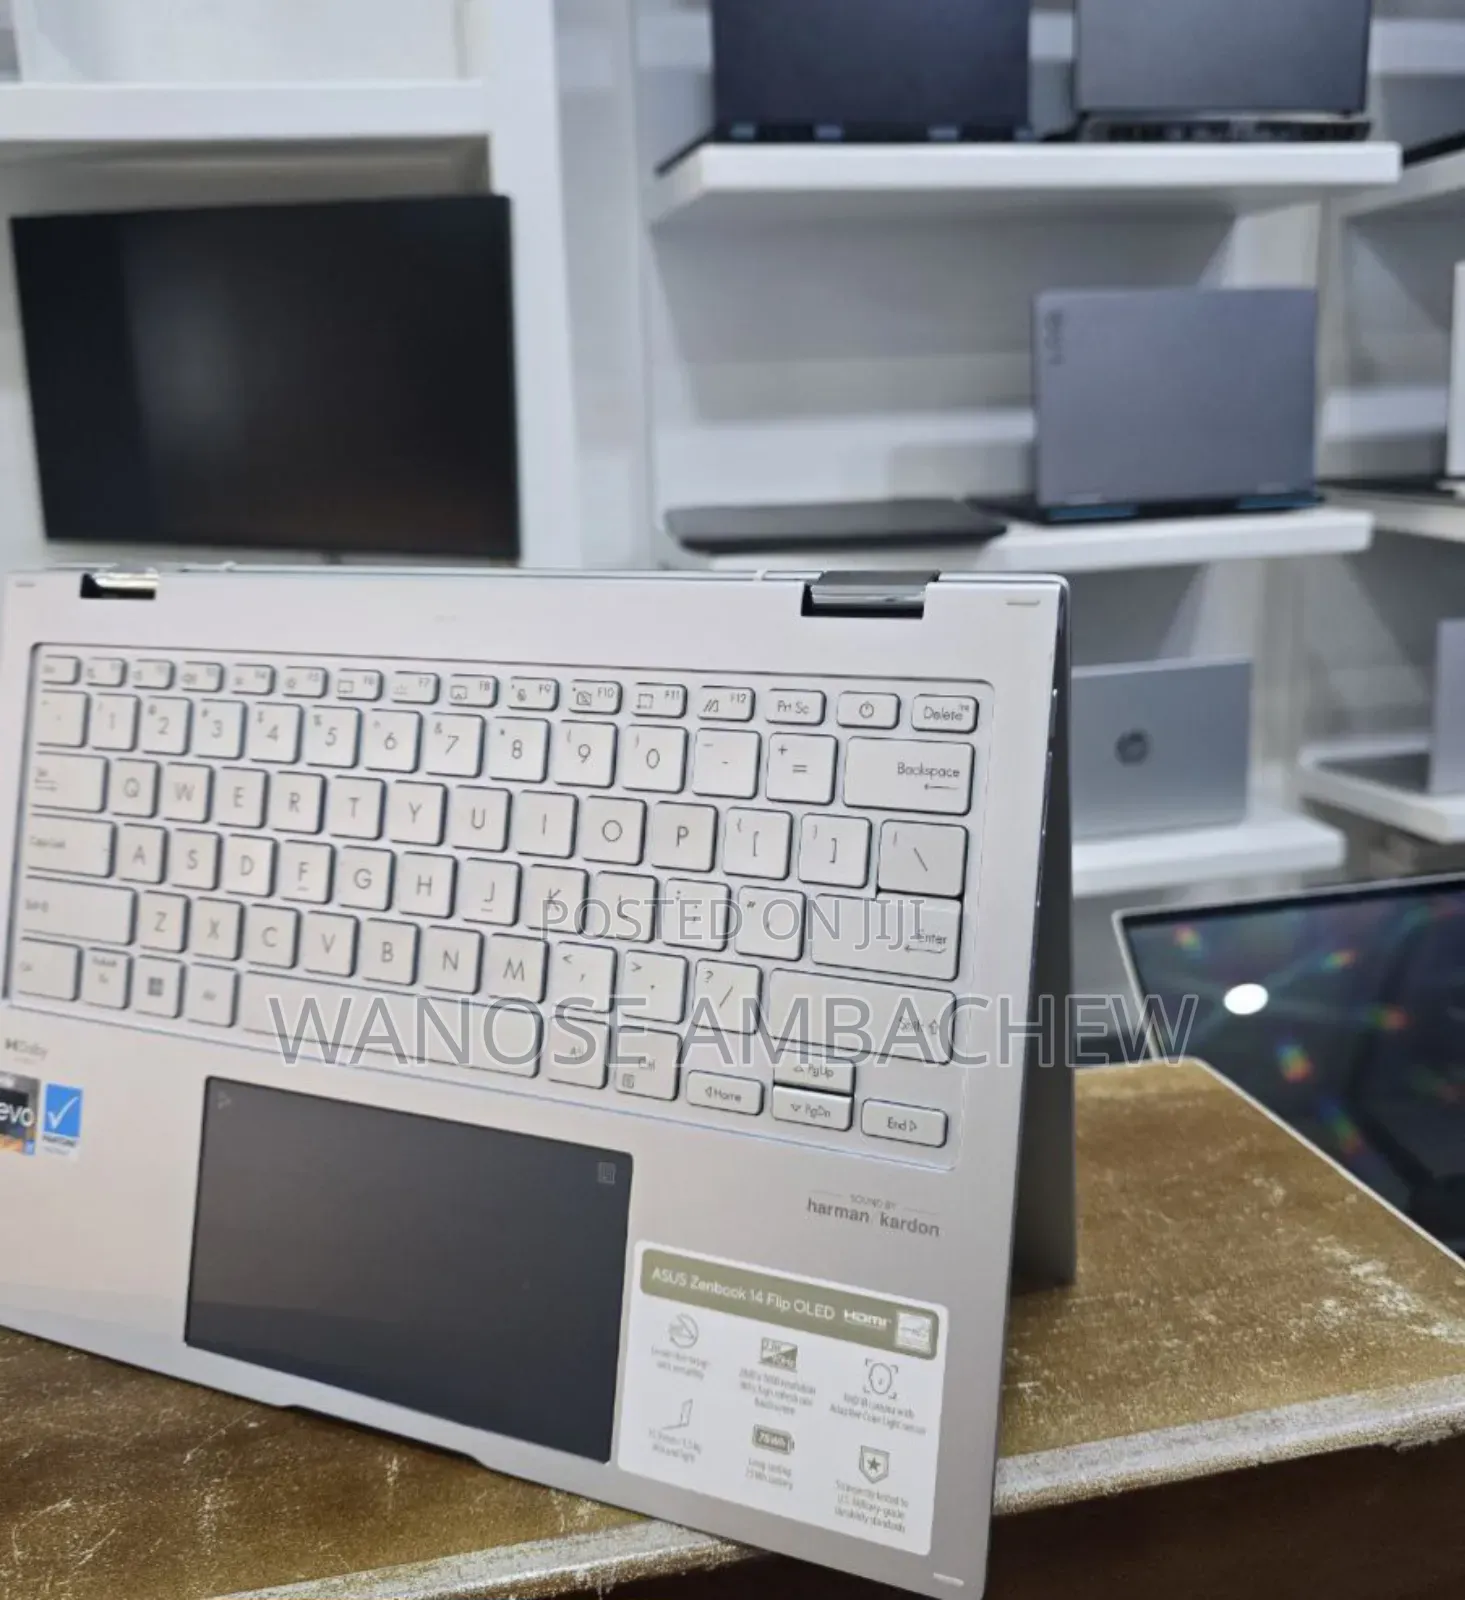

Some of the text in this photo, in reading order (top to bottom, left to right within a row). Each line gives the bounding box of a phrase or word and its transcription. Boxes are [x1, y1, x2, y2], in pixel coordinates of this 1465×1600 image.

[418, 678, 430, 688] F7
[479, 680, 490, 691] F8
[539, 684, 551, 695] F9
[597, 687, 614, 698] F10
[664, 689, 680, 699] F11
[730, 693, 746, 704] F12
[795, 701, 809, 714] Sc
[923, 705, 962, 721] Delete
[157, 717, 170, 735] 2
[211, 720, 223, 738] 3
[266, 725, 279, 742] 4
[325, 727, 337, 746] 5
[384, 732, 397, 750] 6
[445, 735, 459, 754] 7
[512, 739, 523, 759] 8
[578, 744, 591, 763] 9
[647, 749, 660, 769] 0
[897, 761, 960, 778] Backspace
[123, 777, 139, 798] Q
[174, 783, 195, 802] W
[233, 786, 244, 808] E
[289, 791, 300, 813] R
[348, 797, 359, 818] T
[408, 801, 422, 823] Y
[471, 808, 486, 829] U
[602, 820, 623, 842] O
[676, 825, 689, 847] P
[132, 846, 146, 866] A
[186, 850, 198, 869] S
[240, 855, 254, 875] D
[298, 862, 309, 882] F
[354, 869, 372, 889] G
[417, 875, 431, 896] H
[484, 881, 495, 902] J
[549, 889, 560, 911] K
[154, 911, 167, 932] Z
[207, 920, 220, 940] X
[261, 927, 278, 947] C
[321, 934, 335, 954] V
[381, 942, 393, 963] B
[442, 950, 459, 972] N
[503, 958, 525, 981] M
[713, 1089, 741, 1103] Home
[0, 1101, 34, 1128] evo
[804, 1105, 831, 1119] PgDn
[887, 1118, 906, 1132] End
[806, 1197, 940, 1238] harman kardon
[652, 1266, 688, 1288] ASUS
[690, 1274, 747, 1301] Zenbook
[749, 1289, 764, 1304] 14
[766, 1292, 791, 1312] Flip
[793, 1300, 836, 1321] OLED
